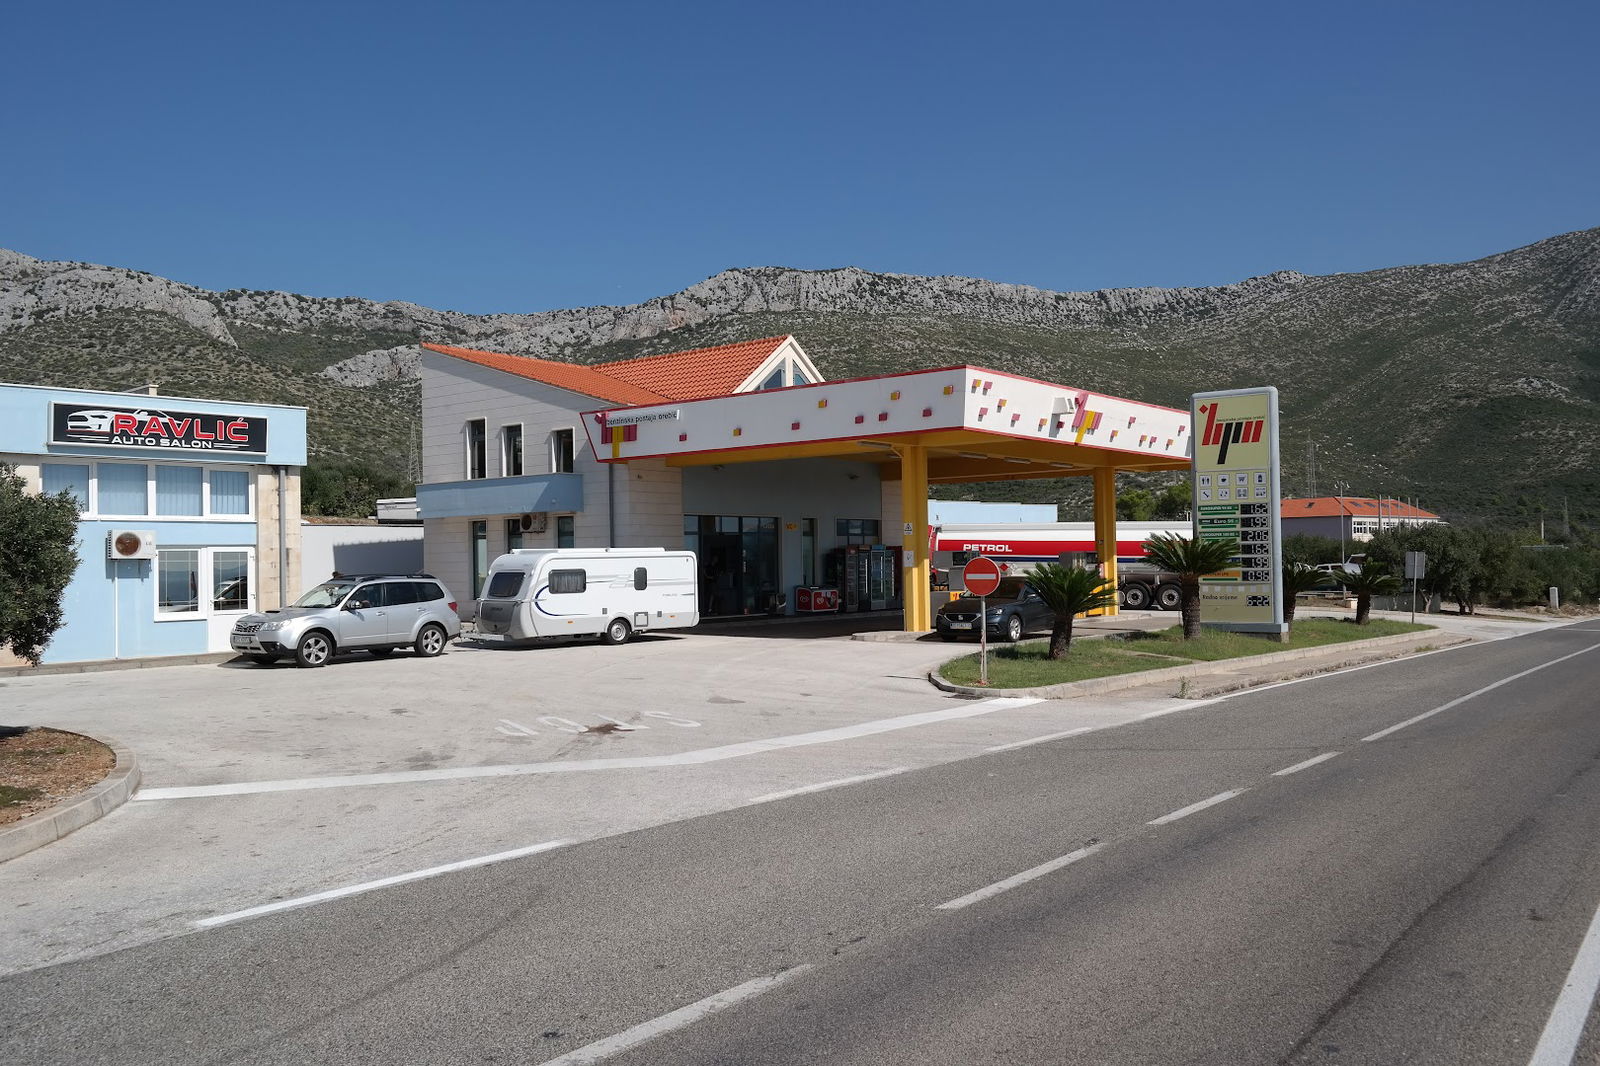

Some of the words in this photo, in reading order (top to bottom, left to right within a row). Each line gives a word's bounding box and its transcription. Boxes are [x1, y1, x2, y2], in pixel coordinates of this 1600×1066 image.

[112, 414, 249, 441] RAVLIĆ
[111, 436, 156, 446] AUTO
[160, 438, 212, 449] SALON
[963, 543, 1013, 552] PETROL
